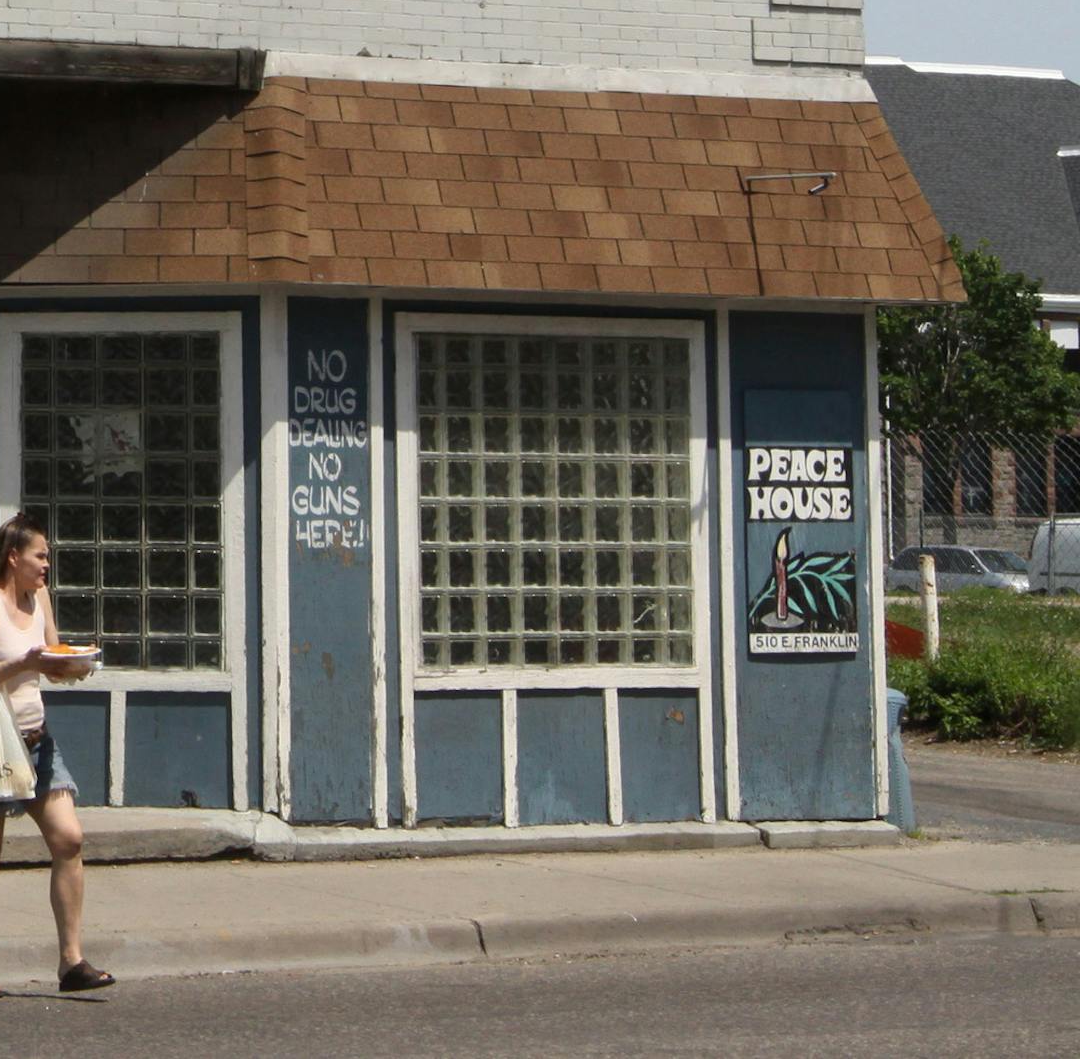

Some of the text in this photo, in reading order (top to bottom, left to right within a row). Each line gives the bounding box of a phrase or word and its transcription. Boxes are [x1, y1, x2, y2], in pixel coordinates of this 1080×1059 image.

[307, 349, 347, 382] NO
[294, 386, 356, 413] DRUG
[289, 419, 367, 448] DEALING
[308, 452, 342, 481] NO
[748, 448, 847, 482] PEACE
[292, 485, 361, 516] GUNS
[748, 486, 851, 520] HOUSE
[756, 636, 778, 648] 510
[794, 636, 857, 648] FRANKLIN
